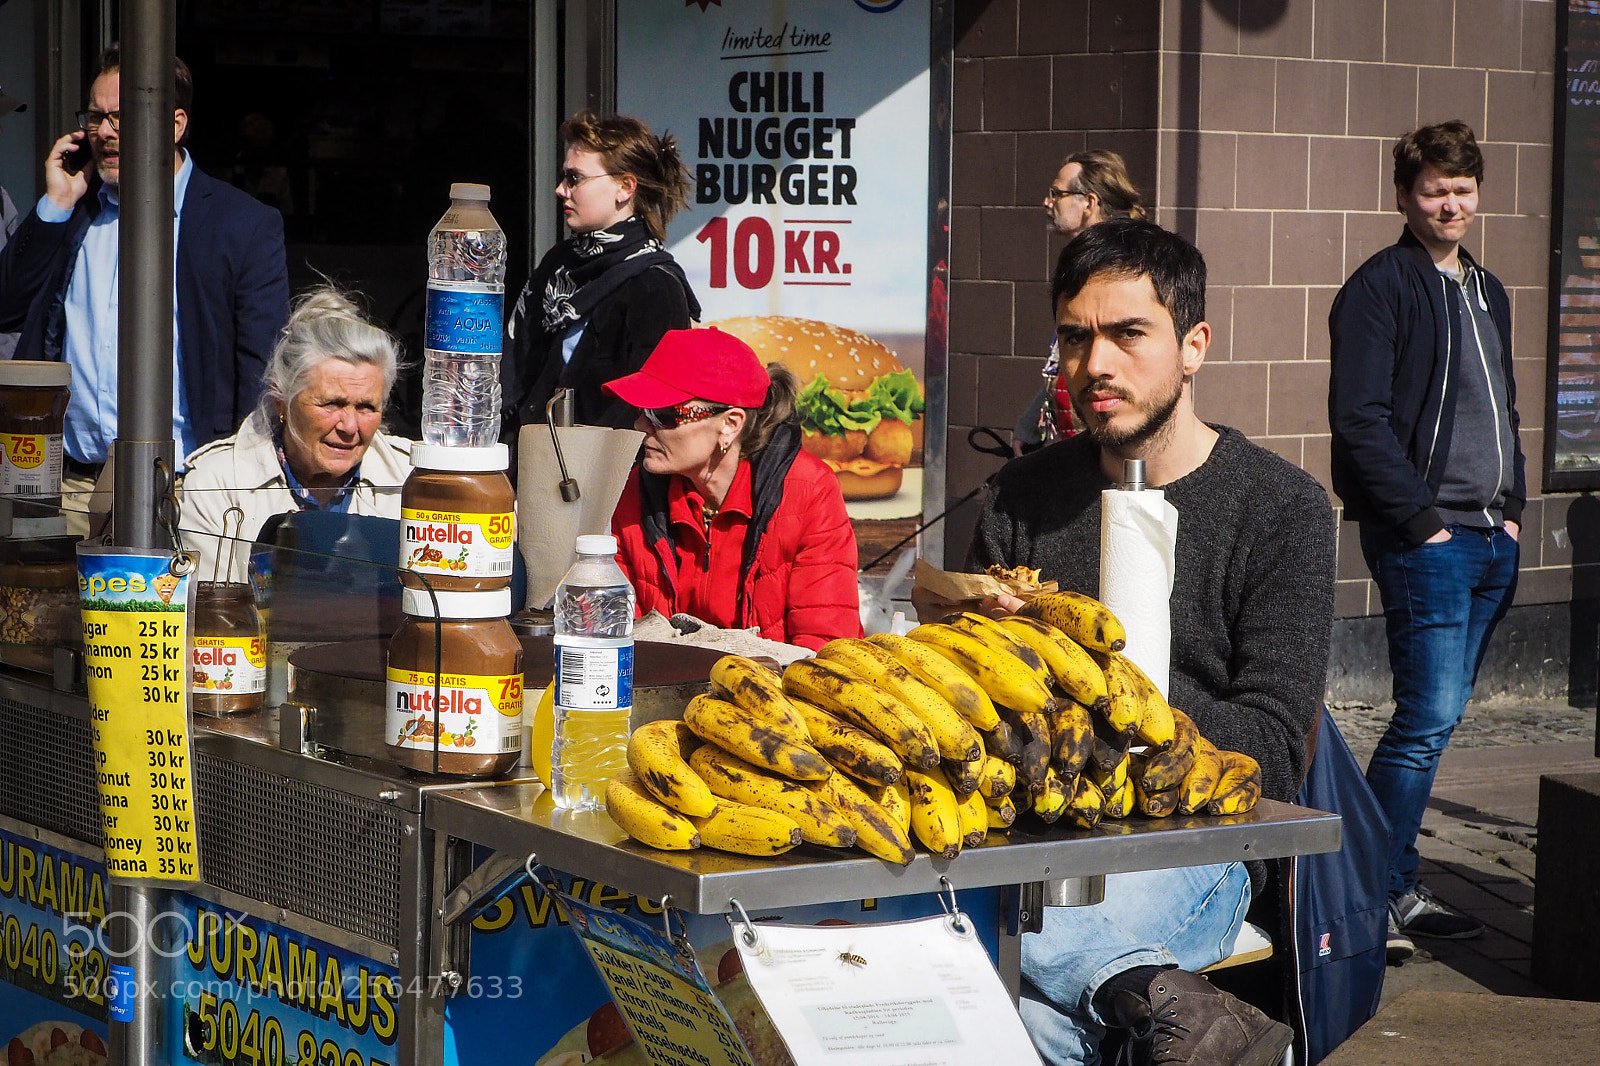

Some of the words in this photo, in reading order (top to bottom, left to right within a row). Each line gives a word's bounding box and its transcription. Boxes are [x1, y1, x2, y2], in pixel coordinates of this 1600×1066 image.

[722, 22, 788, 50] limited
[790, 27, 832, 48] time
[729, 72, 824, 112] CHILI
[698, 118, 856, 159] NUGGET
[696, 164, 858, 206] BURGER
[696, 216, 775, 290] 10
[784, 230, 852, 274] KR.
[454, 318, 492, 332] AQUA
[11, 436, 36, 454] 75
[12, 456, 40, 464] GRATIS
[432, 513, 460, 522] GRATIS
[488, 516, 510, 535] 50
[406, 524, 472, 544] nutella
[490, 536, 512, 544] GRATIS
[138, 621, 158, 637] 25
[162, 620, 180, 637] kr
[140, 643, 158, 659] 25
[162, 642, 180, 659] kr
[193, 648, 236, 666] tella
[141, 665, 159, 680] 25
[163, 664, 180, 681] kr
[408, 674, 418, 682] 75
[427, 676, 466, 686] GRATIS
[142, 686, 160, 702] 30
[164, 686, 180, 703] kr
[498, 678, 520, 700] 75
[396, 690, 481, 714] nutella
[498, 701, 522, 710] GRATIS
[146, 730, 163, 745] 30
[167, 729, 182, 746] kr
[148, 751, 166, 767] 30
[170, 751, 184, 768] kr
[150, 772, 167, 788] 30
[171, 772, 186, 790] kr
[152, 794, 168, 810] 30
[173, 794, 187, 811] kr
[154, 816, 171, 831] 30
[175, 816, 190, 832] kr
[156, 837, 174, 852] 30
[177, 837, 191, 854] kr
[158, 858, 175, 874] 35
[179, 858, 193, 875] kr
[0, 909, 59, 986] 040
[186, 906, 400, 1046] JURAMAJS
[592, 946, 635, 974] Sukker
[638, 964, 674, 991] Sugar
[603, 966, 638, 991] Kanel
[643, 982, 702, 1019] Cinnamon
[702, 1008, 720, 1028] 25
[614, 986, 652, 1012] Citron
[656, 1002, 698, 1032] Lemon
[713, 1028, 730, 1047] 25
[624, 1005, 668, 1034] Nutella
